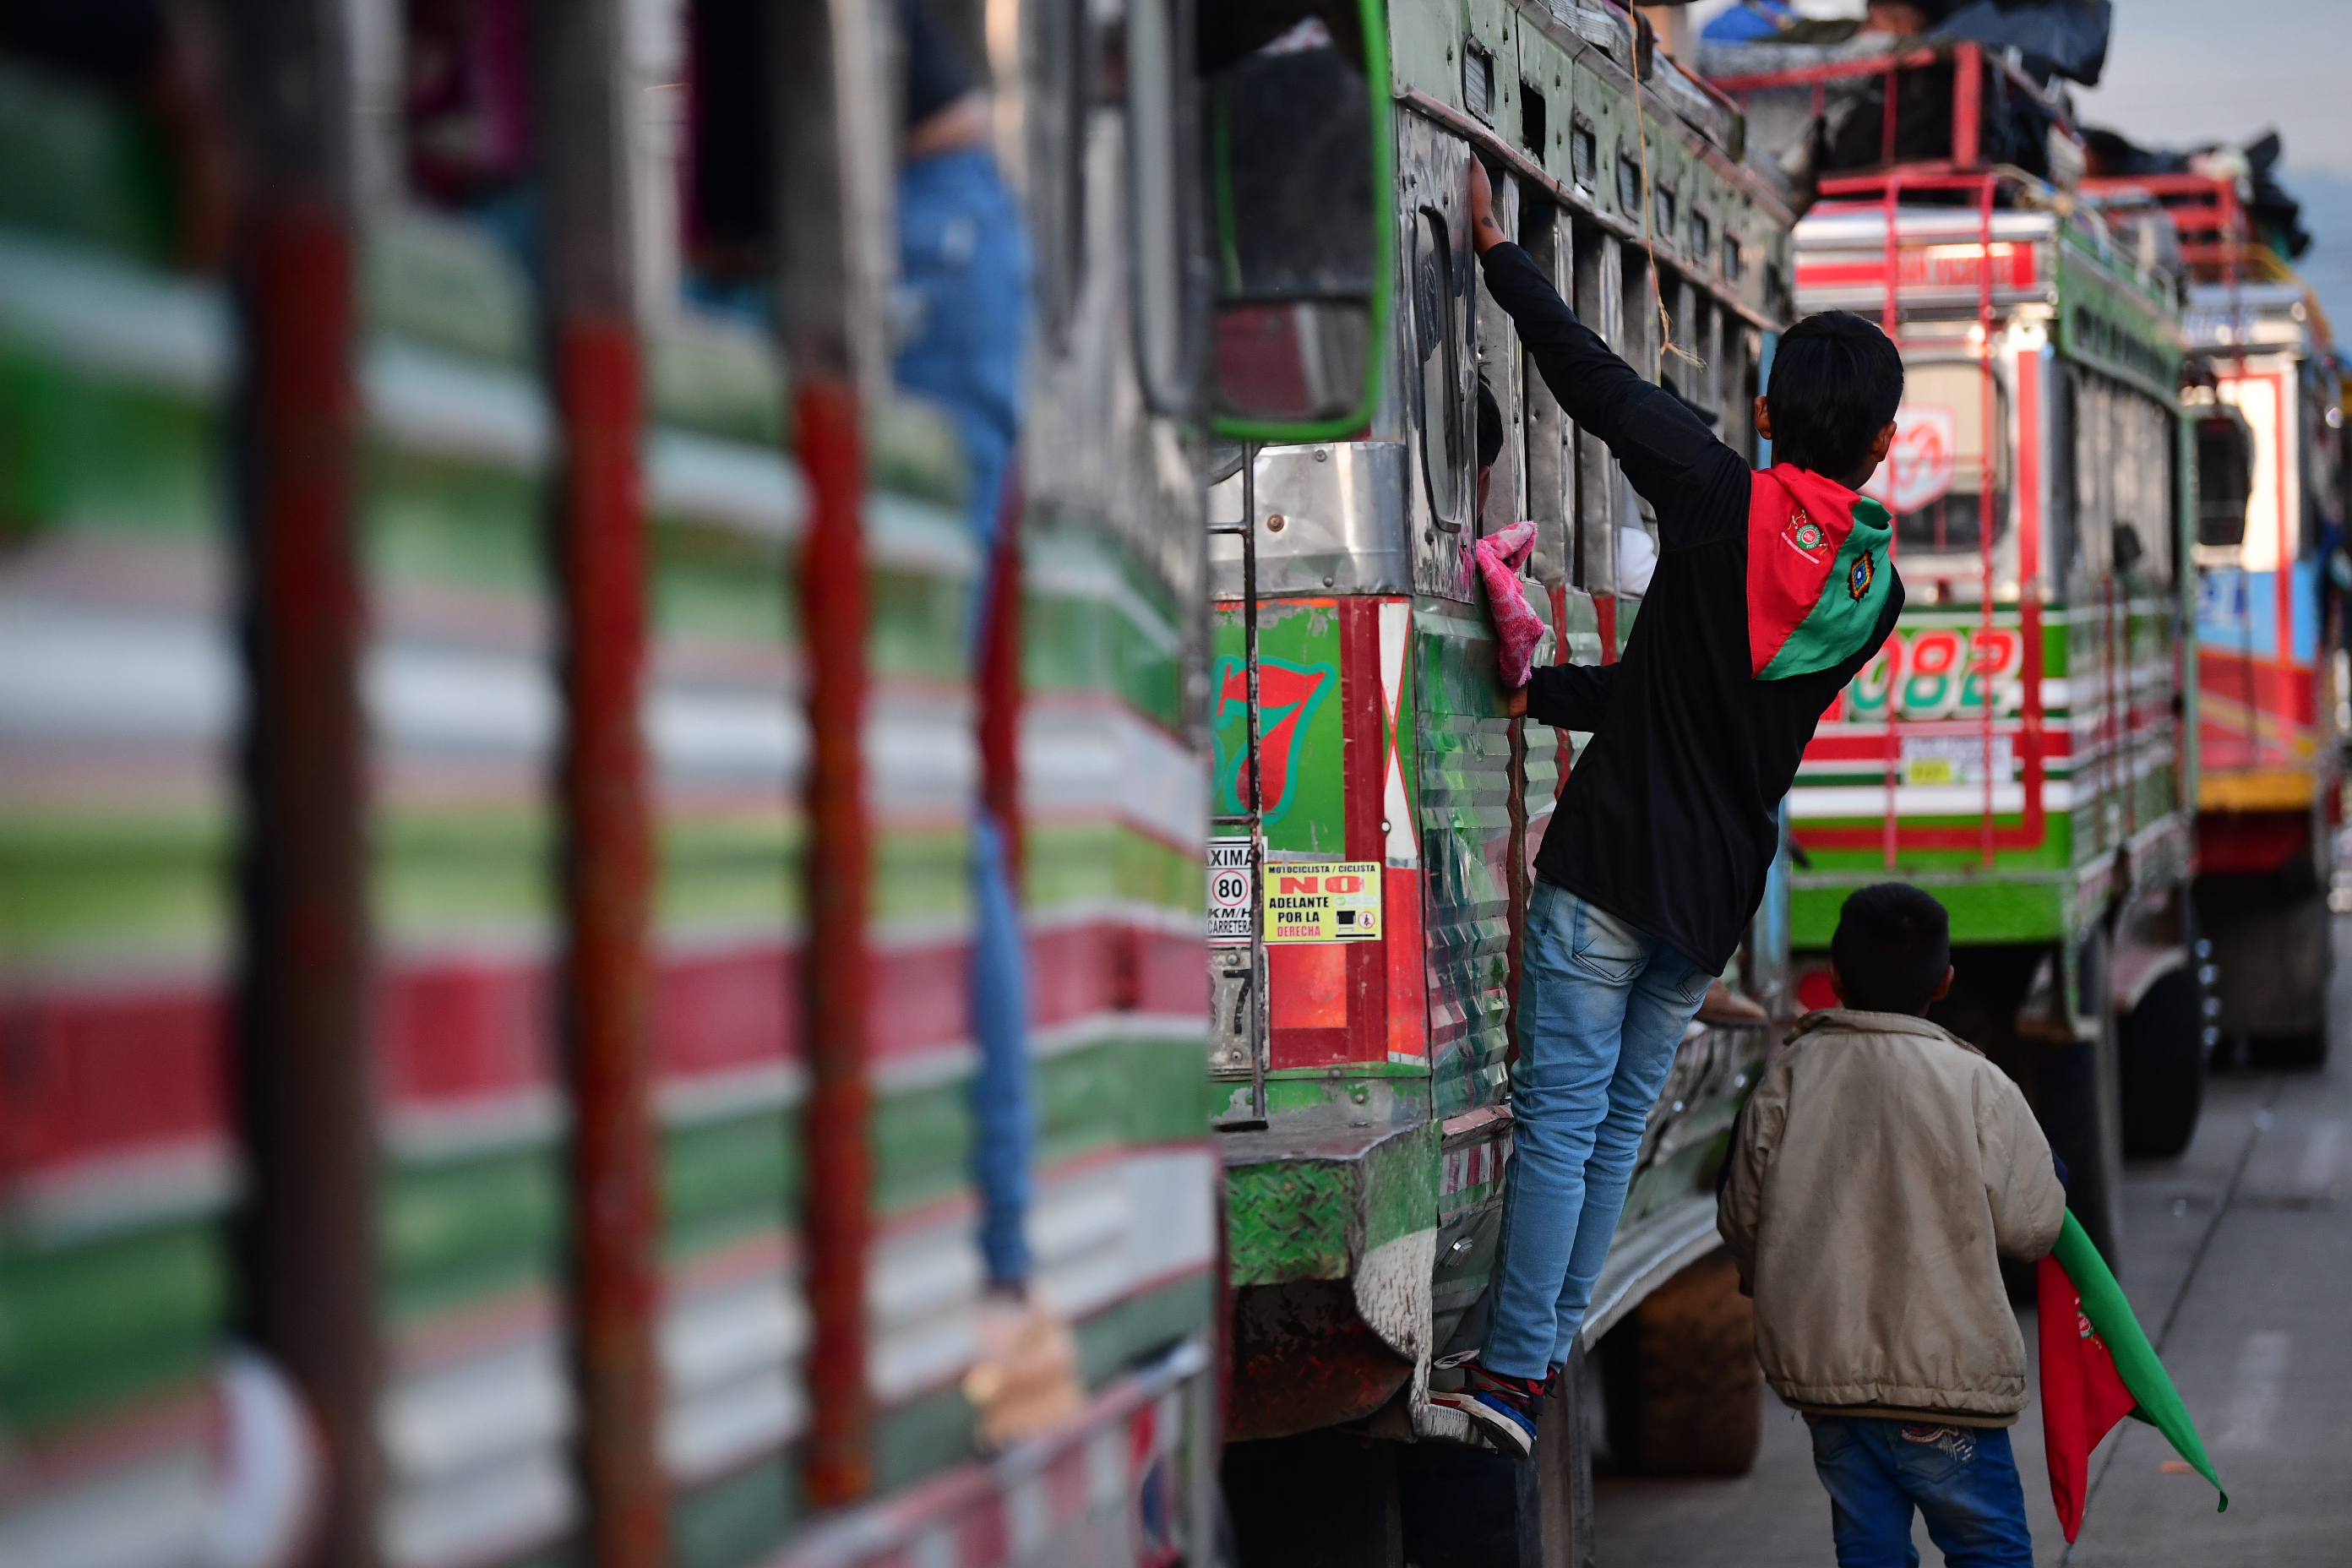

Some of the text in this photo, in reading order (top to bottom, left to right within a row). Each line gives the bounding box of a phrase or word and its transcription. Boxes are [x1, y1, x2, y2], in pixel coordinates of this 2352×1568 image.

[1218, 879, 1242, 897] 80
[1280, 875, 1364, 894] NO
[1269, 897, 1329, 908] ADELANTE
[1278, 912, 1320, 923] POR LA
[1277, 926, 1320, 937] DERECHA
